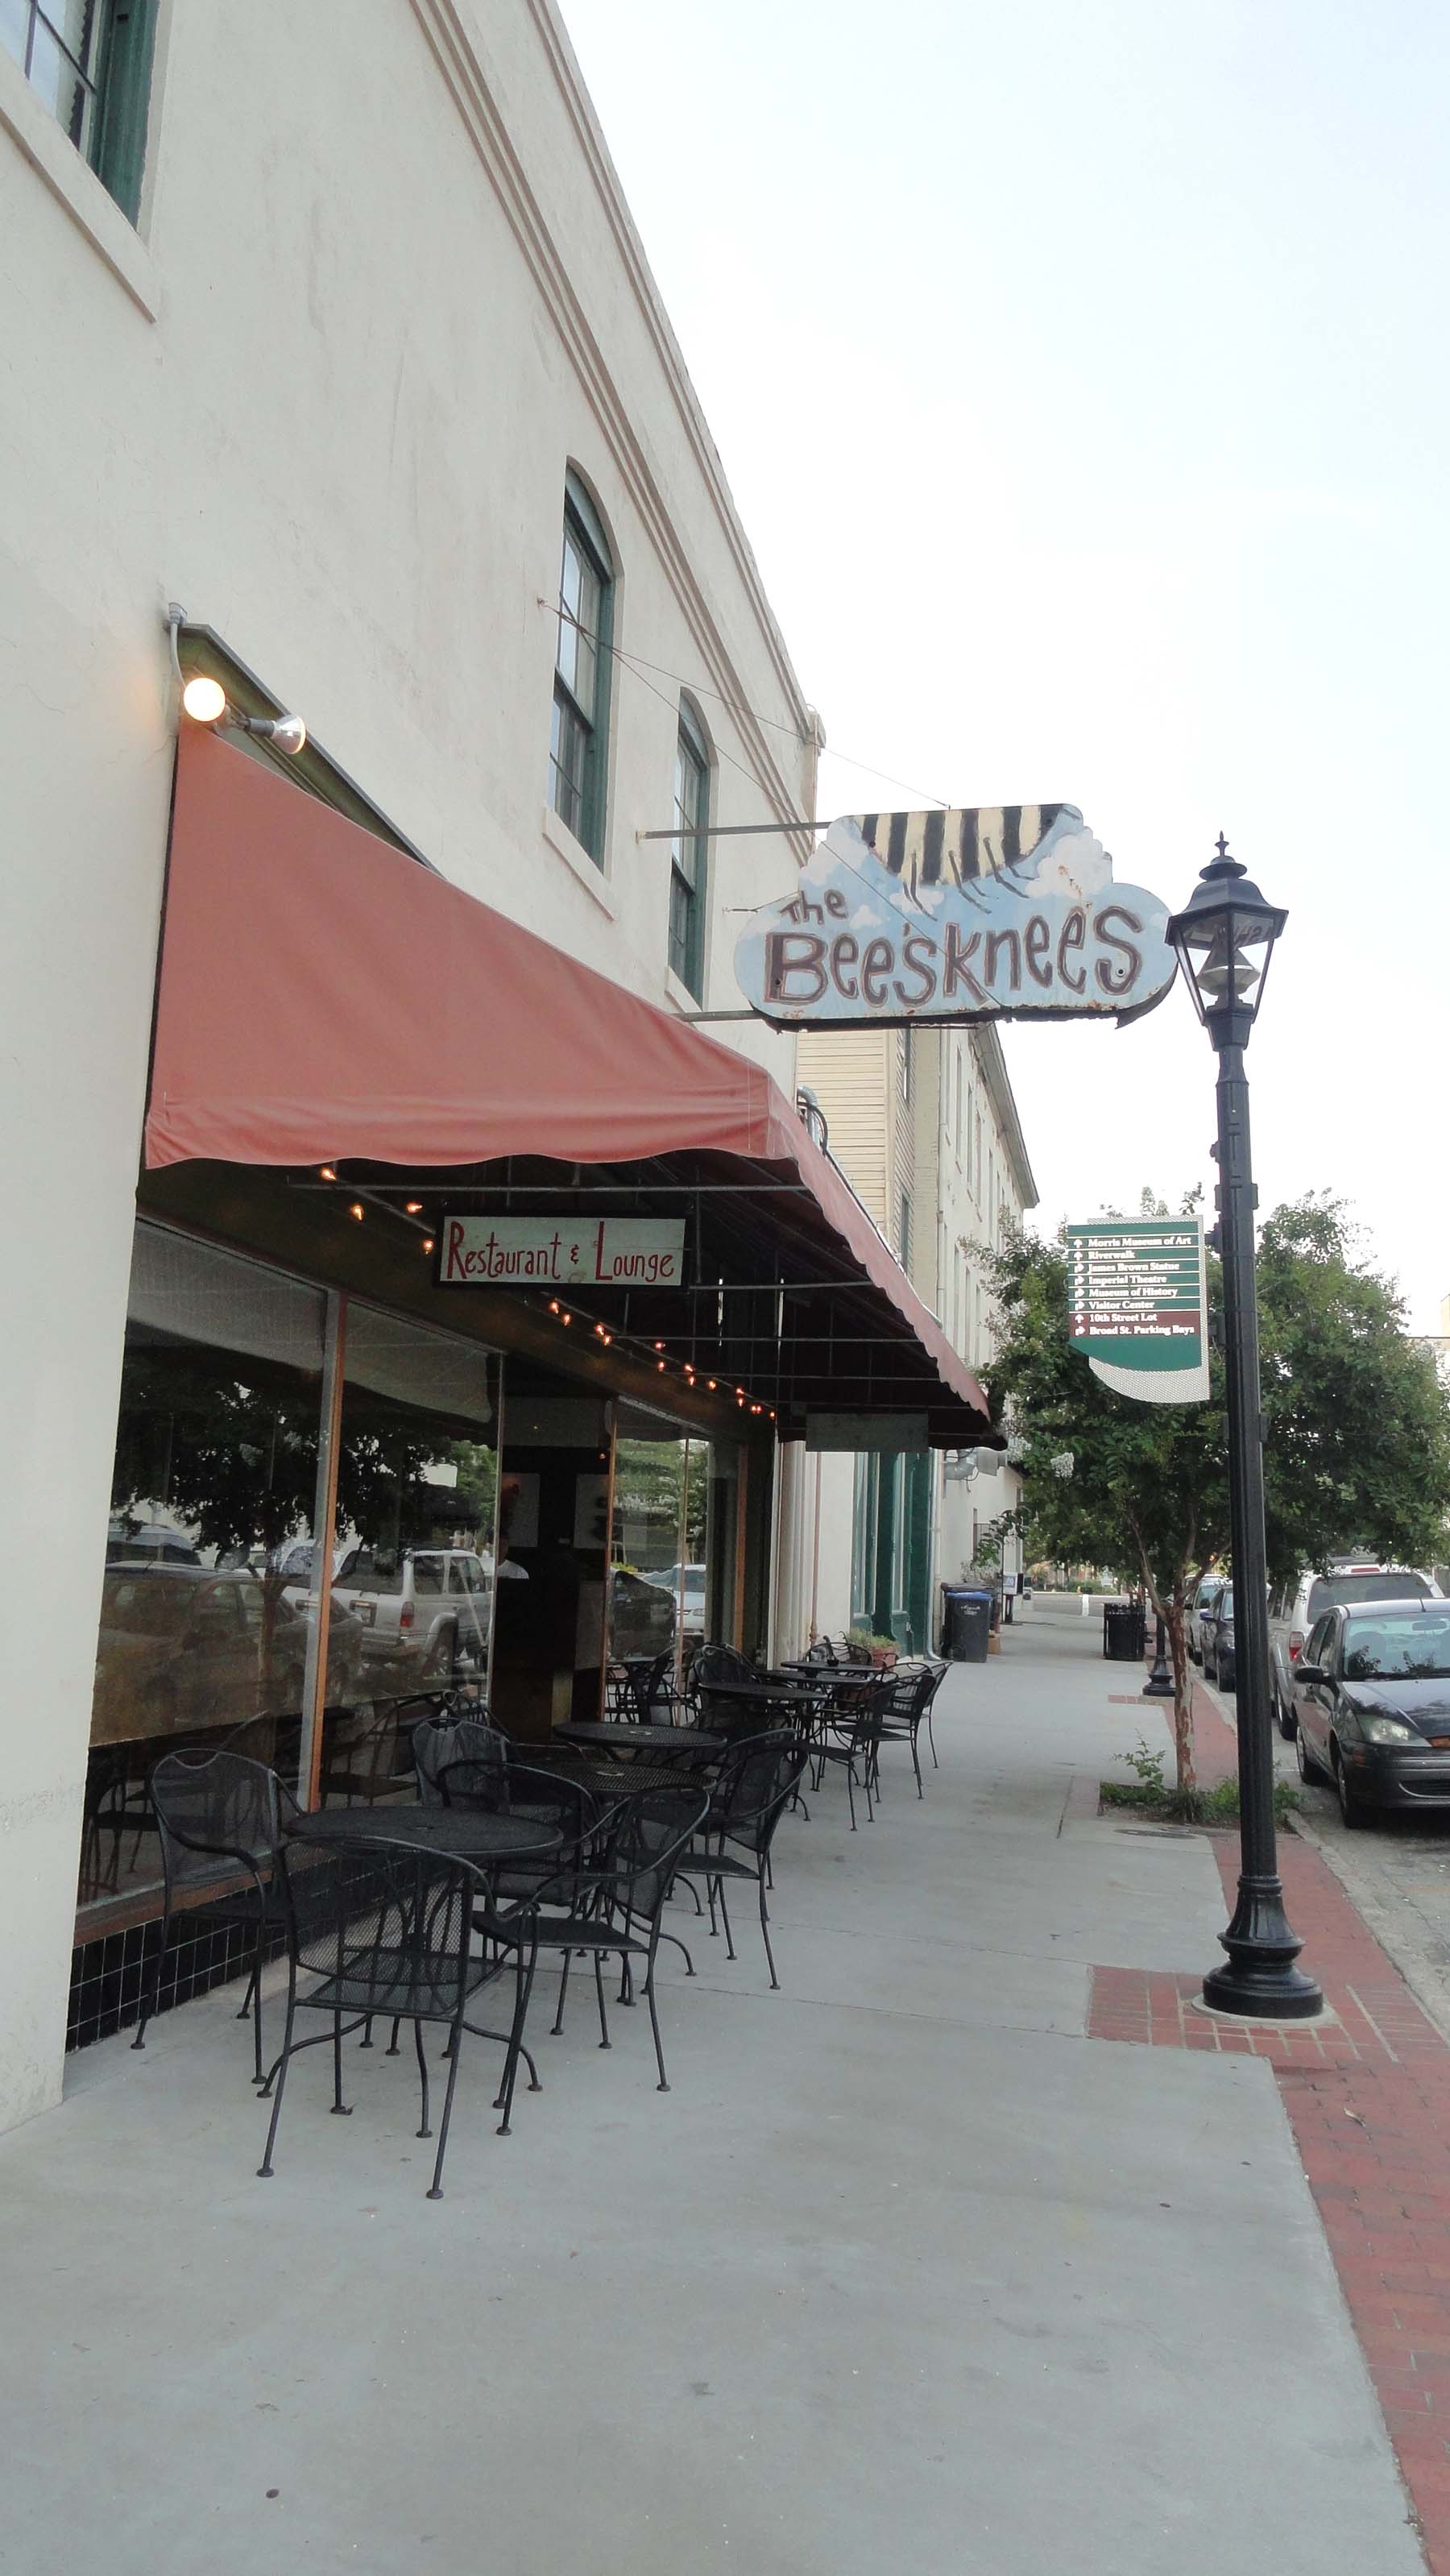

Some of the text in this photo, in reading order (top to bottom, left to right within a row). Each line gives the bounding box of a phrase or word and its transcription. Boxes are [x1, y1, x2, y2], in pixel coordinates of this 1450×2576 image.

[780, 890, 849, 926] The
[1088, 1236, 1191, 1247] Morris Museum of Art
[447, 1221, 561, 1280] Restaurant
[595, 1221, 675, 1283] Lounge
[1088, 1251, 1135, 1259] Riverwalk
[1088, 1262, 1179, 1274] James Brown Statue
[1088, 1275, 1167, 1287] Imperial Theatre
[1088, 1288, 1178, 1298] Museum of History
[1088, 1300, 1155, 1310] Visitor Center
[1089, 1313, 1158, 1322] 10th Street Lot
[1089, 1325, 1195, 1336] Broad St. Parking Bays
